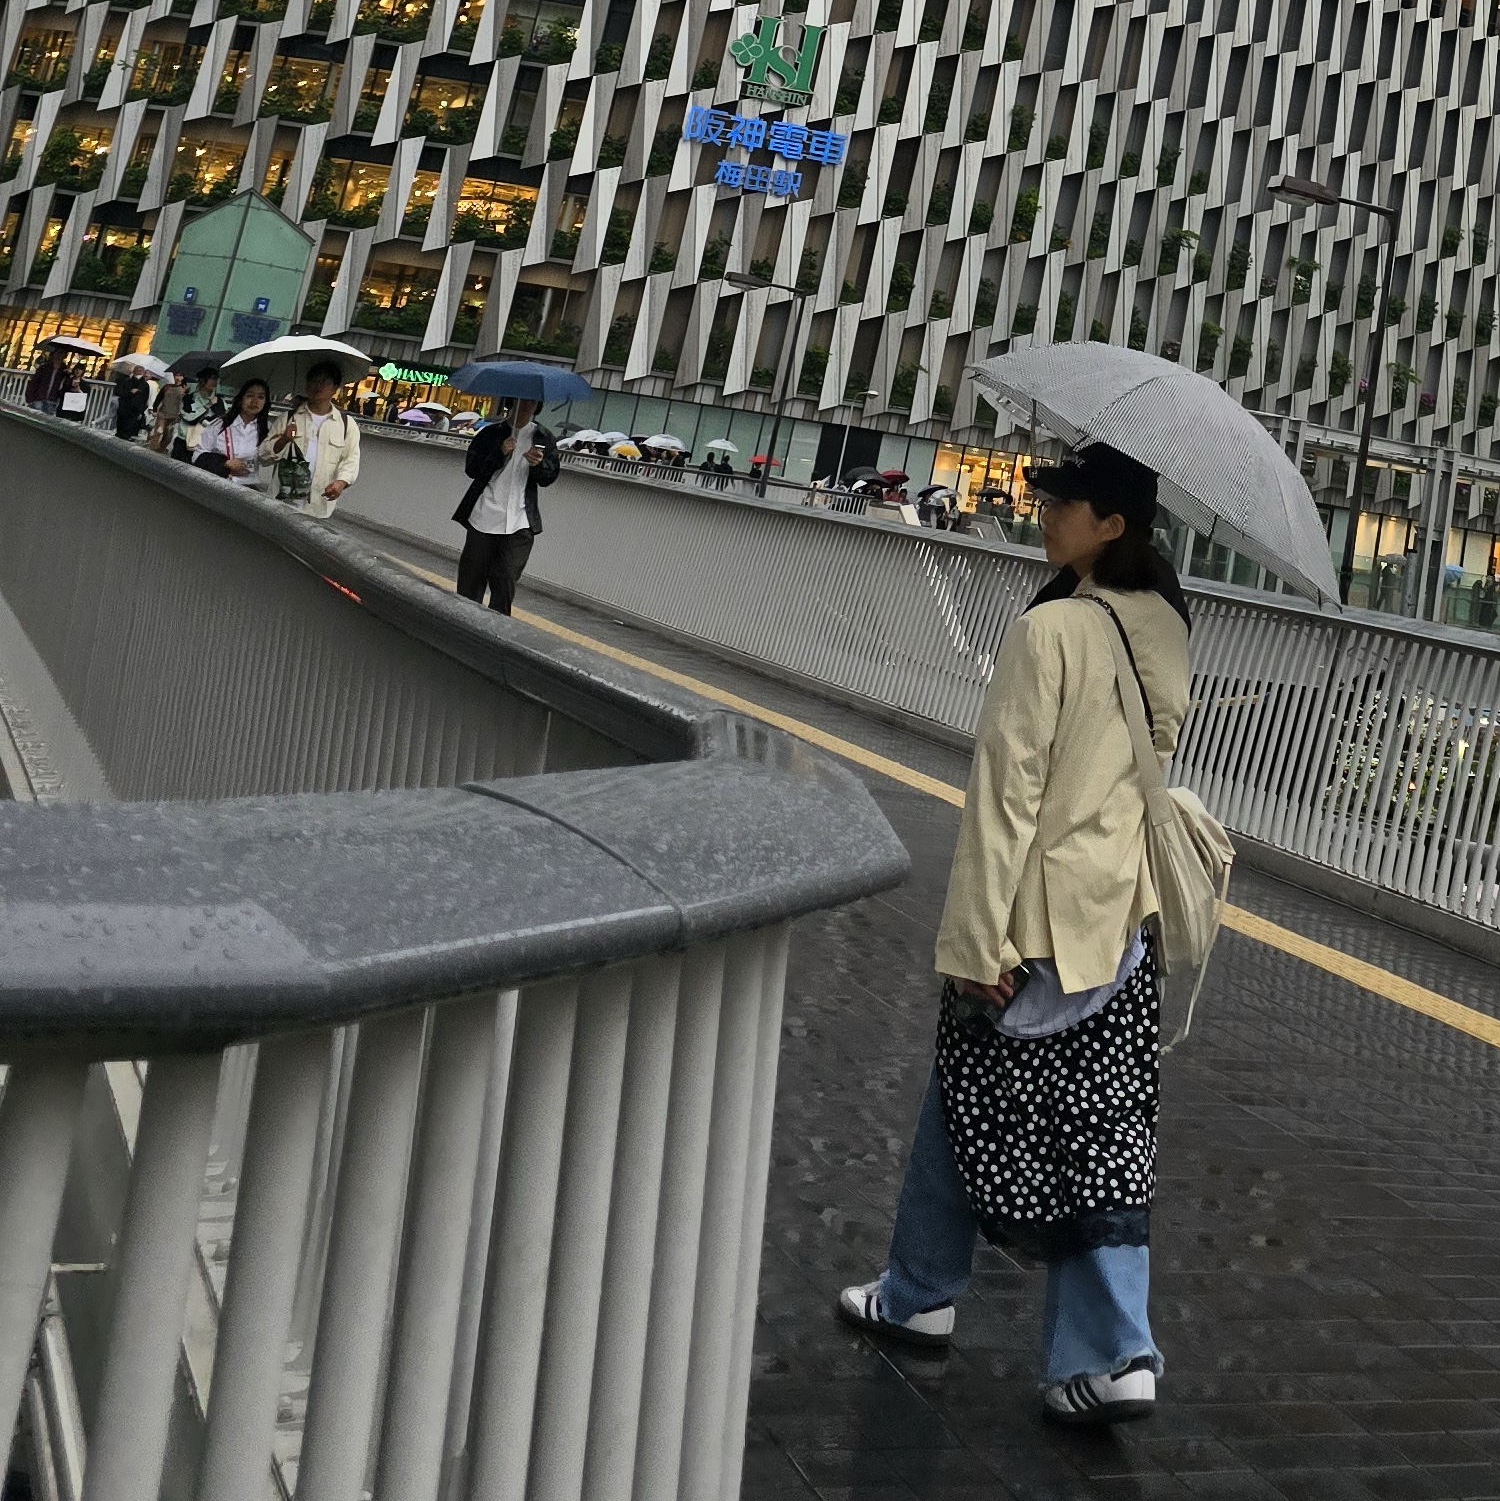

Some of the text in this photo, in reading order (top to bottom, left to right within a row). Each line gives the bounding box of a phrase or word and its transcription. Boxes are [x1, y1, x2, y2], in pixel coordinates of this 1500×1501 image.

[744, 83, 809, 106] HANSHIN
[684, 106, 847, 165] 阪神電車
[715, 160, 802, 198] 梅田駅
